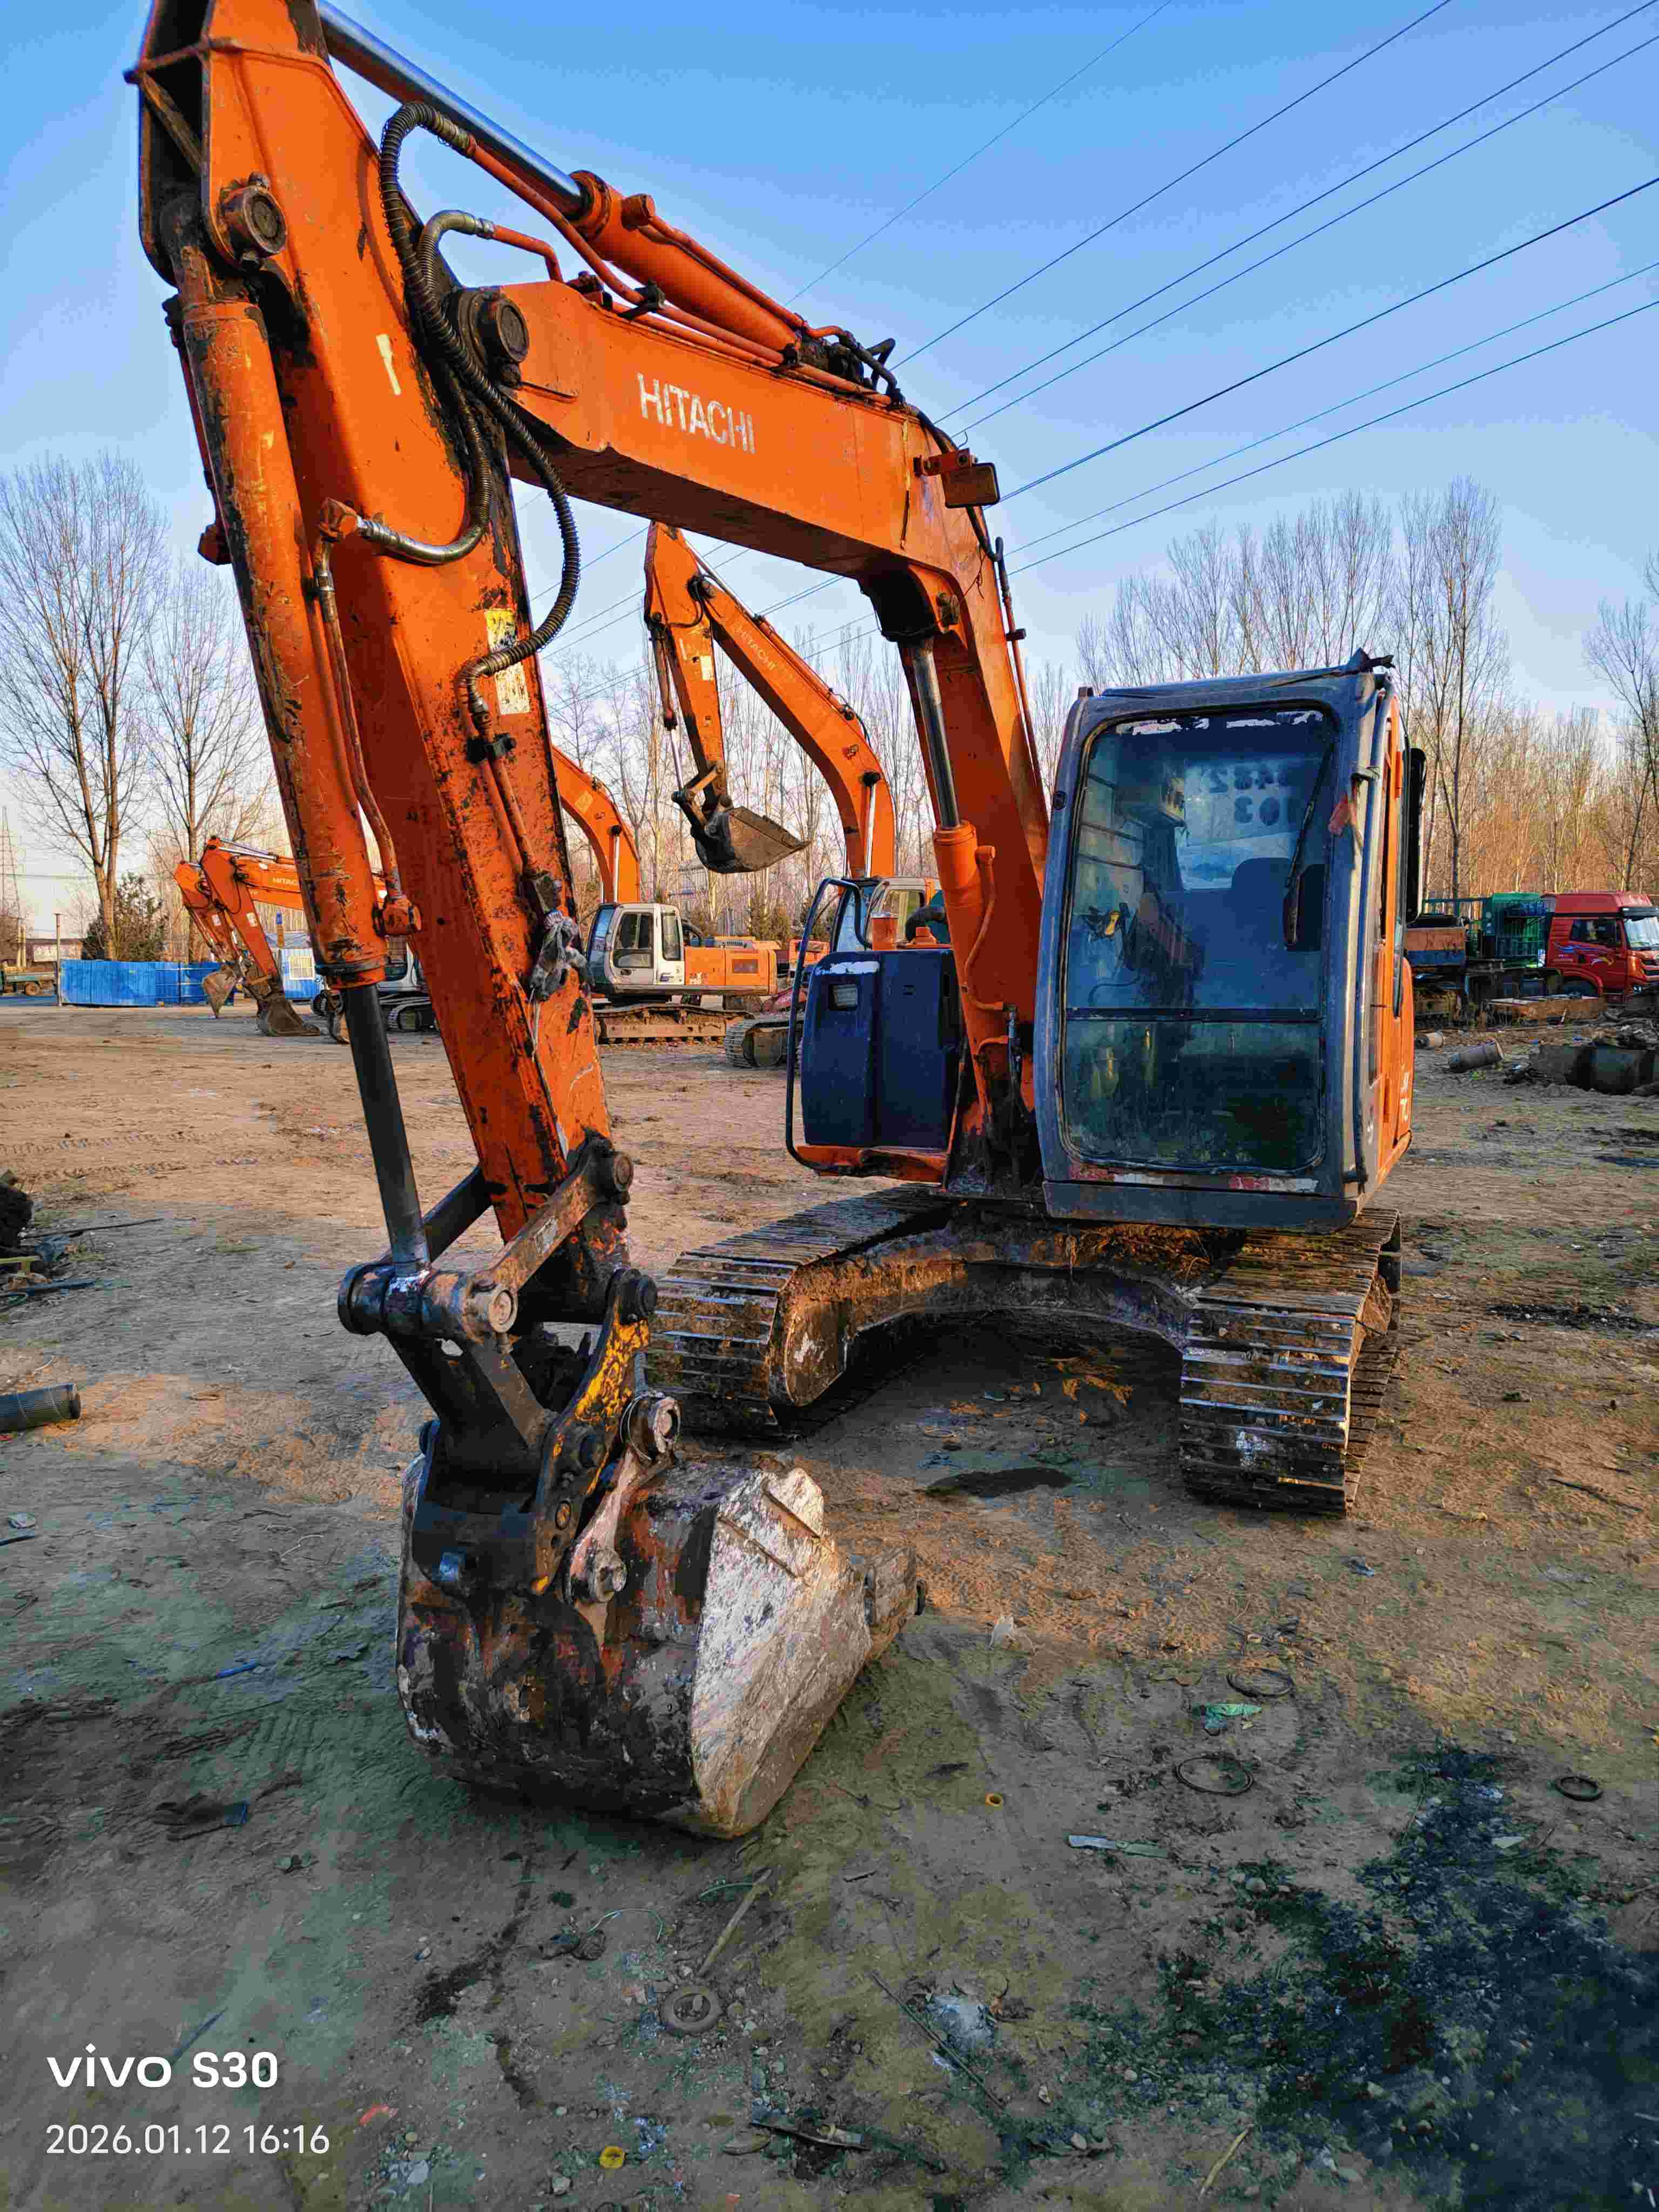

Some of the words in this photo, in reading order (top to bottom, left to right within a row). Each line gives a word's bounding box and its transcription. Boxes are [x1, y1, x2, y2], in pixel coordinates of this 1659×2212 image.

[636, 372, 756, 454] HITACHI
[738, 629, 778, 670] HITACHI
[272, 877, 300, 886] HITAC
